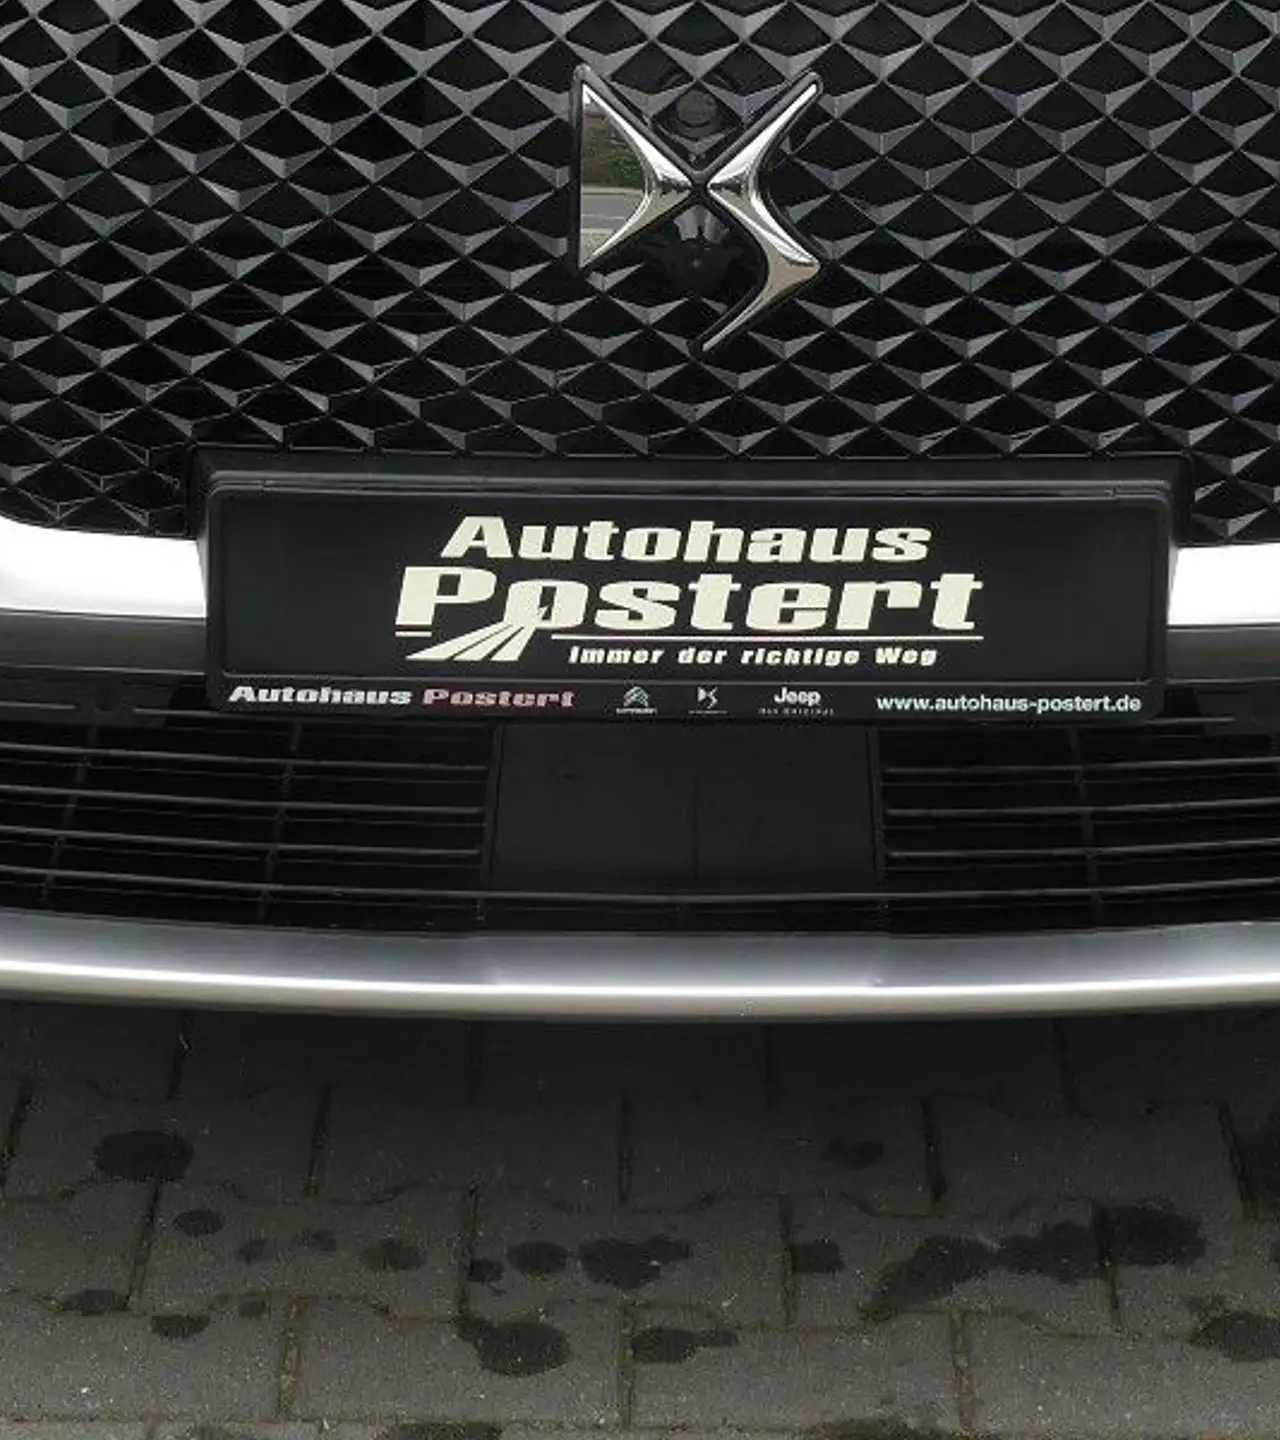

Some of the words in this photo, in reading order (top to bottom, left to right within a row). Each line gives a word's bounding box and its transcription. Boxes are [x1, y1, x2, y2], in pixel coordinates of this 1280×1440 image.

[440, 515, 932, 564] Autohaus
[395, 565, 984, 632] Postert
[568, 645, 665, 665] Immer
[677, 647, 728, 665] der
[740, 647, 861, 667] richtige
[874, 647, 938, 667] Weg
[228, 685, 414, 706] Autohaus
[422, 687, 576, 709] Postert
[773, 686, 822, 708] Jeep
[876, 693, 1142, 715] www.autohaus-postert.de
